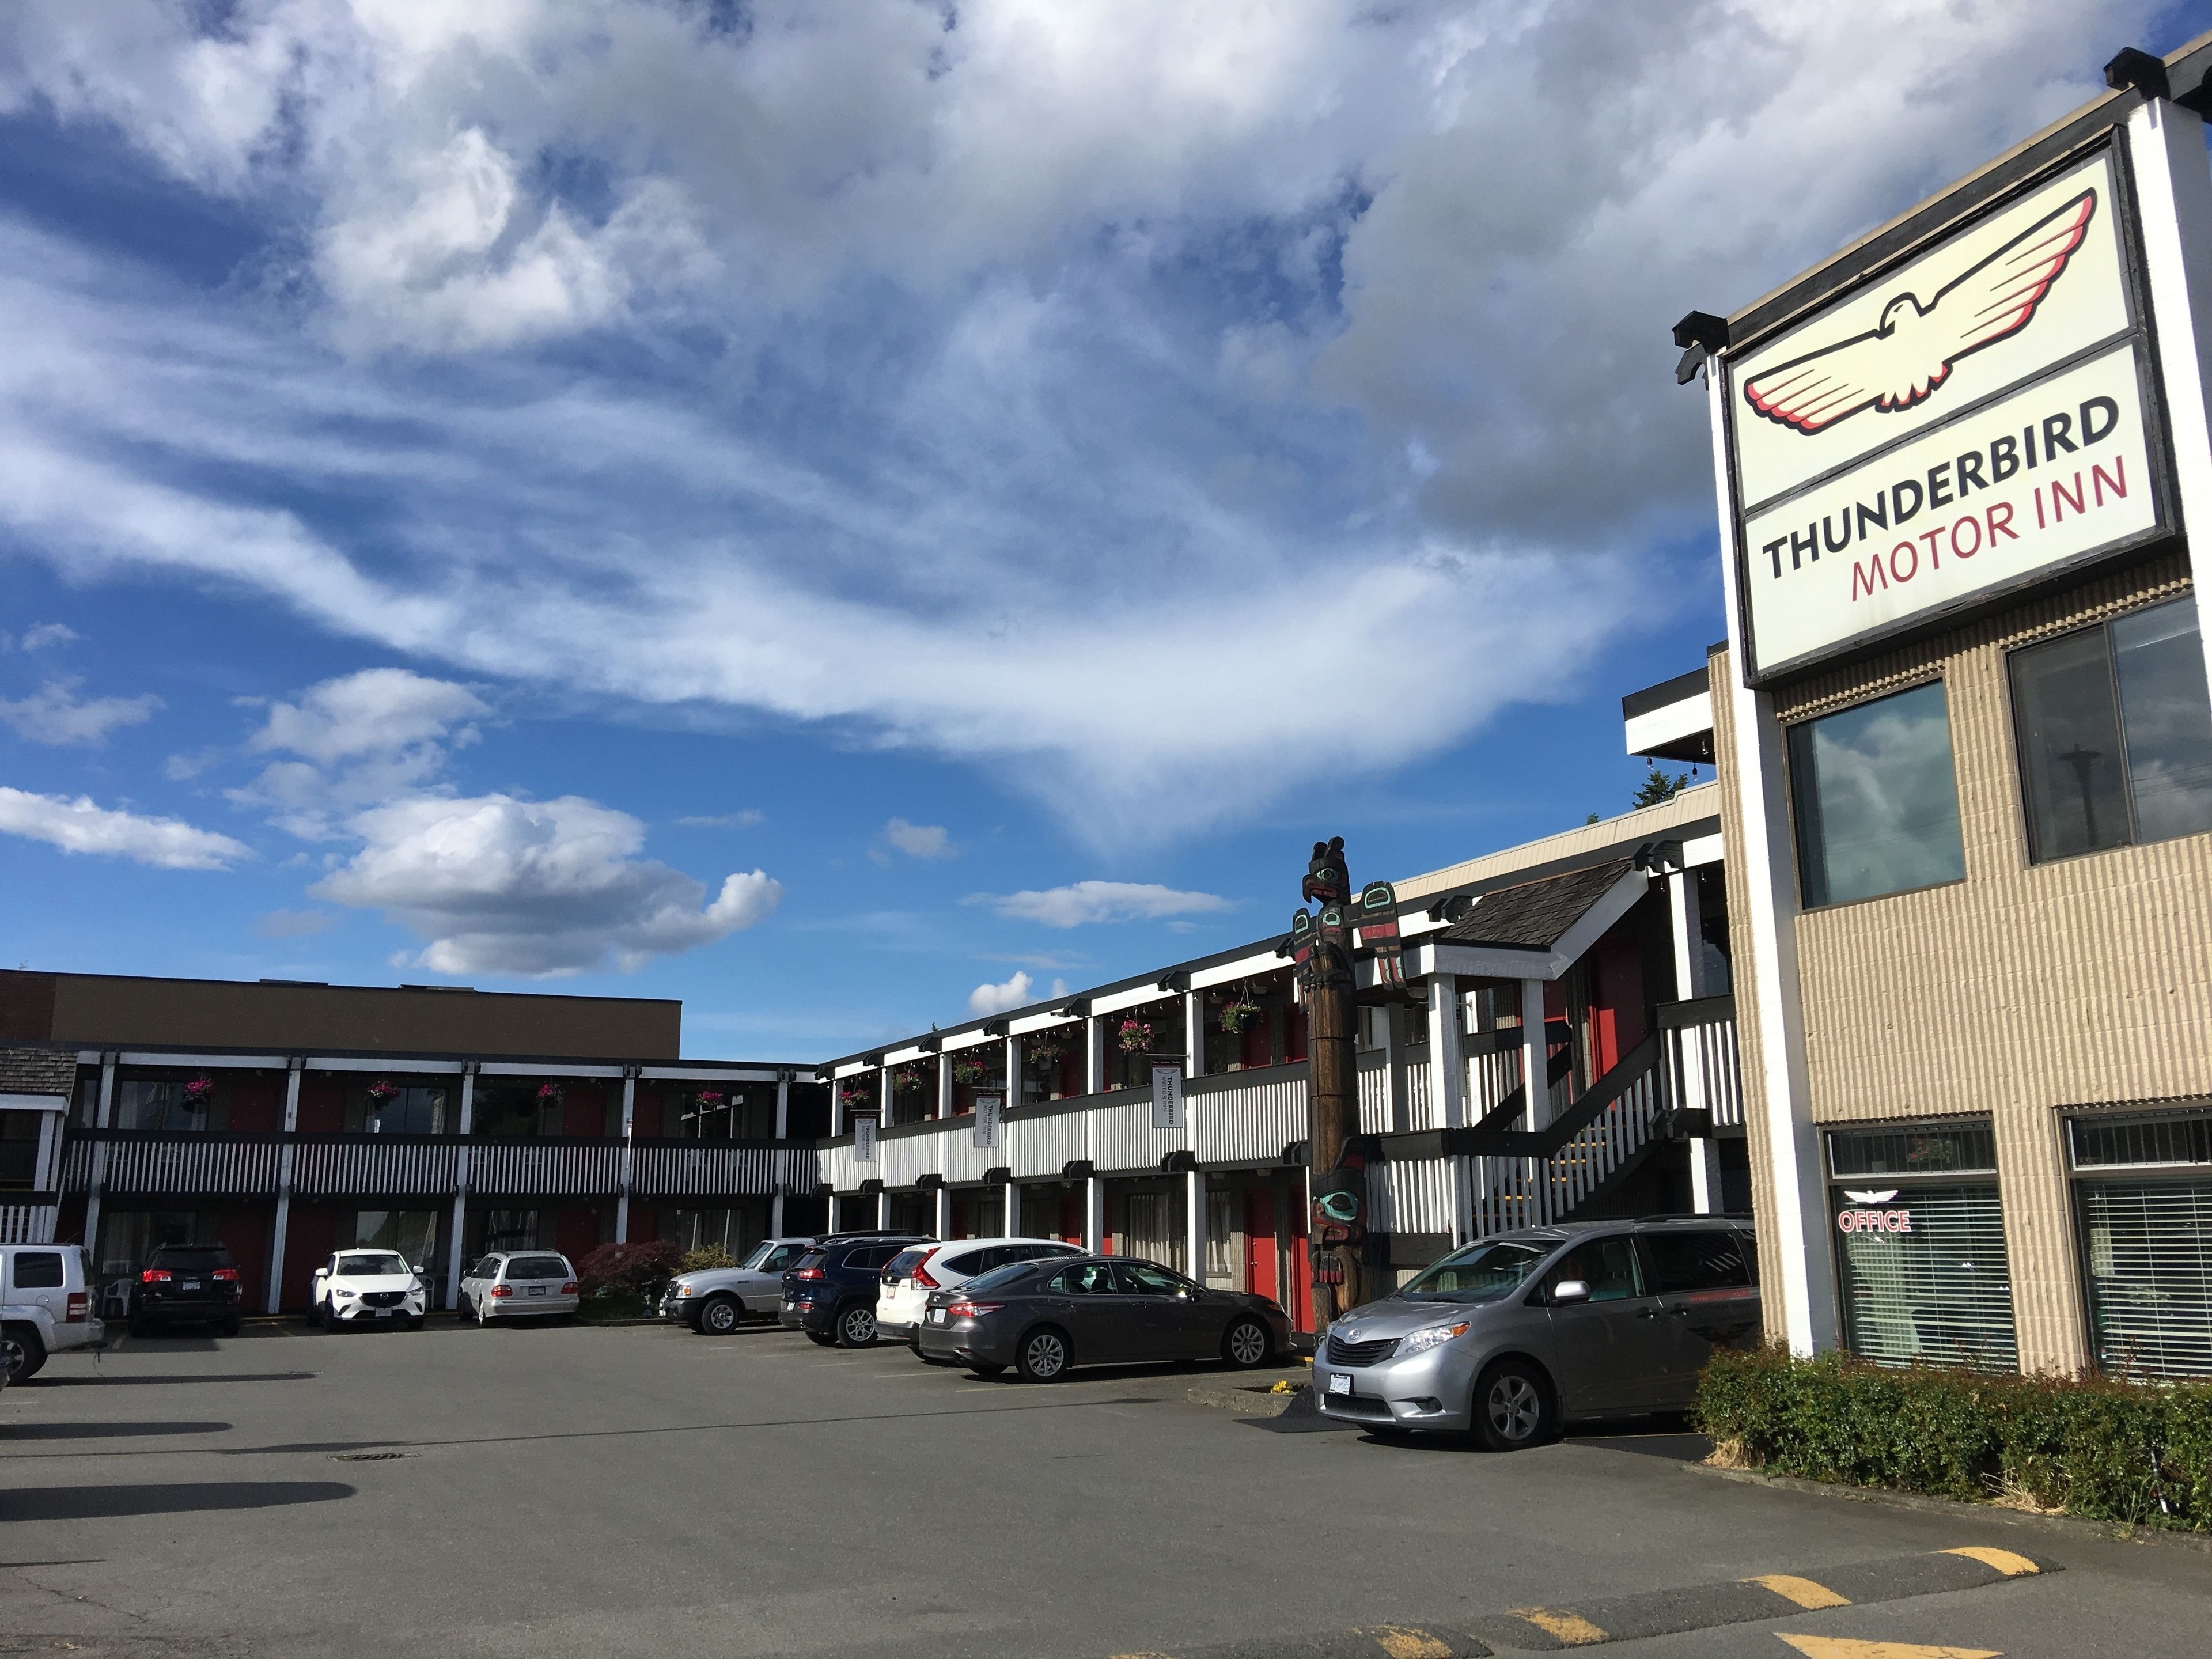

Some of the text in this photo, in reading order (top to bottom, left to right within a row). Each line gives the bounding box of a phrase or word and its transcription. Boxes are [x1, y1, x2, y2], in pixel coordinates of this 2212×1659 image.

[1762, 395, 2120, 579] THUNDERBIRD
[1852, 454, 2128, 602] MOTOR INN
[1839, 1210, 1912, 1233] OFFICE
